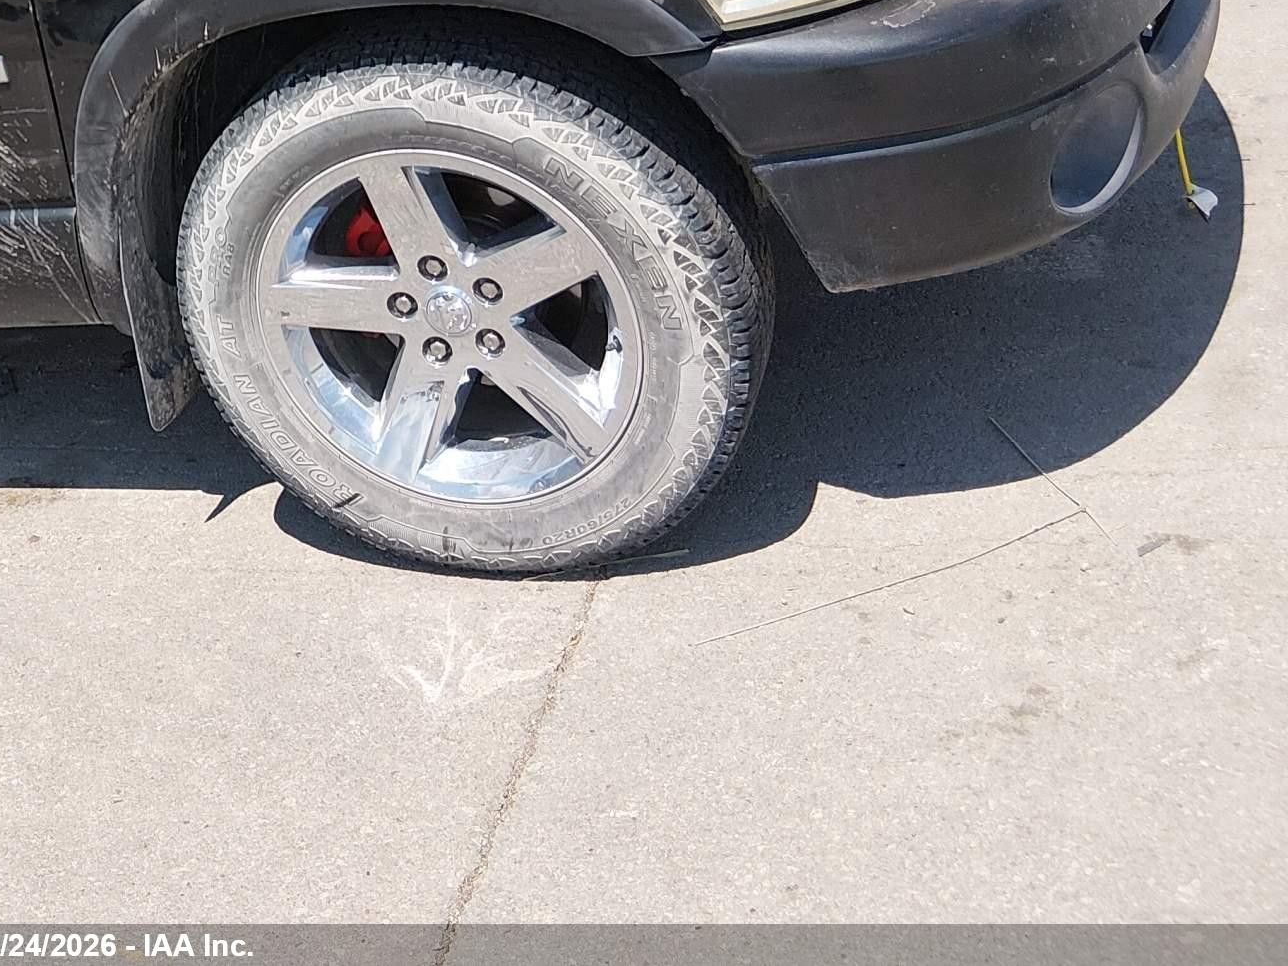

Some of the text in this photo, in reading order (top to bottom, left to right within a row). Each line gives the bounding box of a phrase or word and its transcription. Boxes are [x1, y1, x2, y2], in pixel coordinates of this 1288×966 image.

[222, 242, 235, 276] RA8
[544, 157, 684, 331] NEXEN
[215, 314, 242, 358] AT
[233, 374, 365, 506] ROADIAN
[542, 497, 631, 545] 275/60R20
